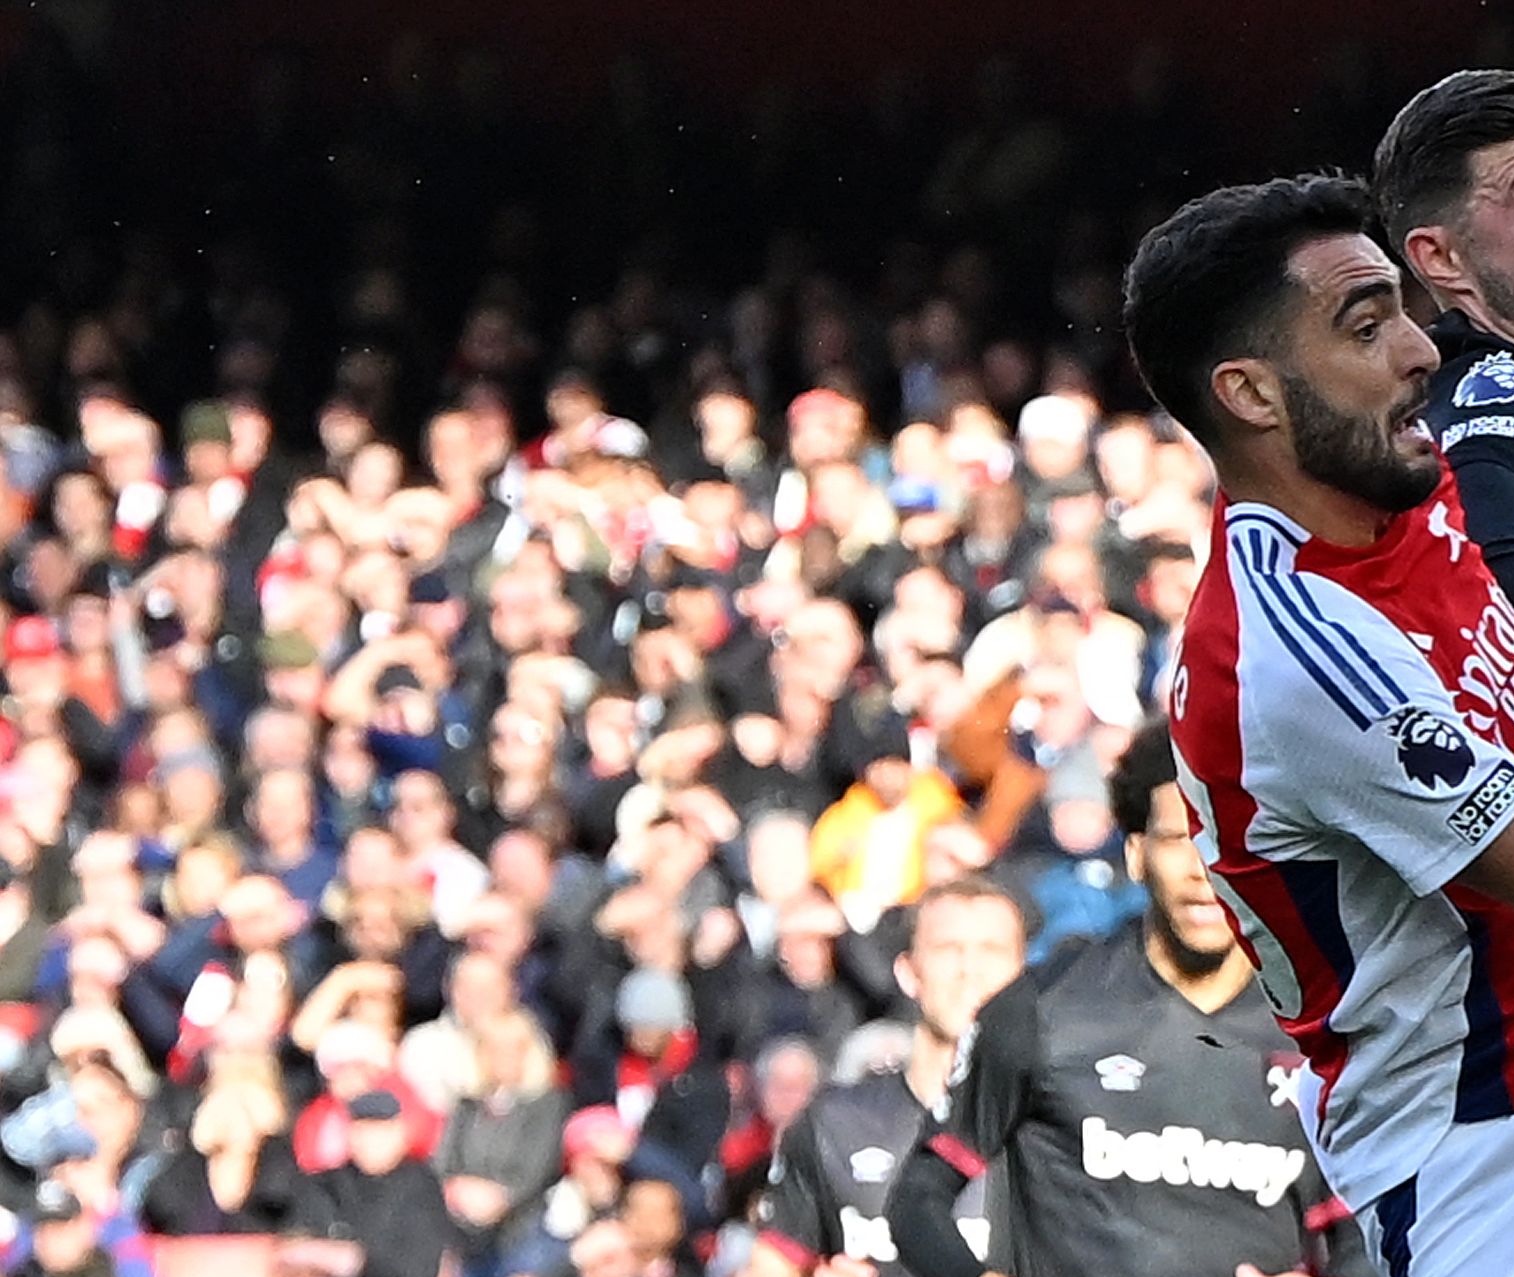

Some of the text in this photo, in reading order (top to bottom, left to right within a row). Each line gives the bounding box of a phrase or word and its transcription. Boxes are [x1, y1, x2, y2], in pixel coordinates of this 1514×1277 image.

[1448, 805, 1479, 839] No
[1463, 815, 1489, 845] for
[1082, 1116, 1306, 1208] betway
